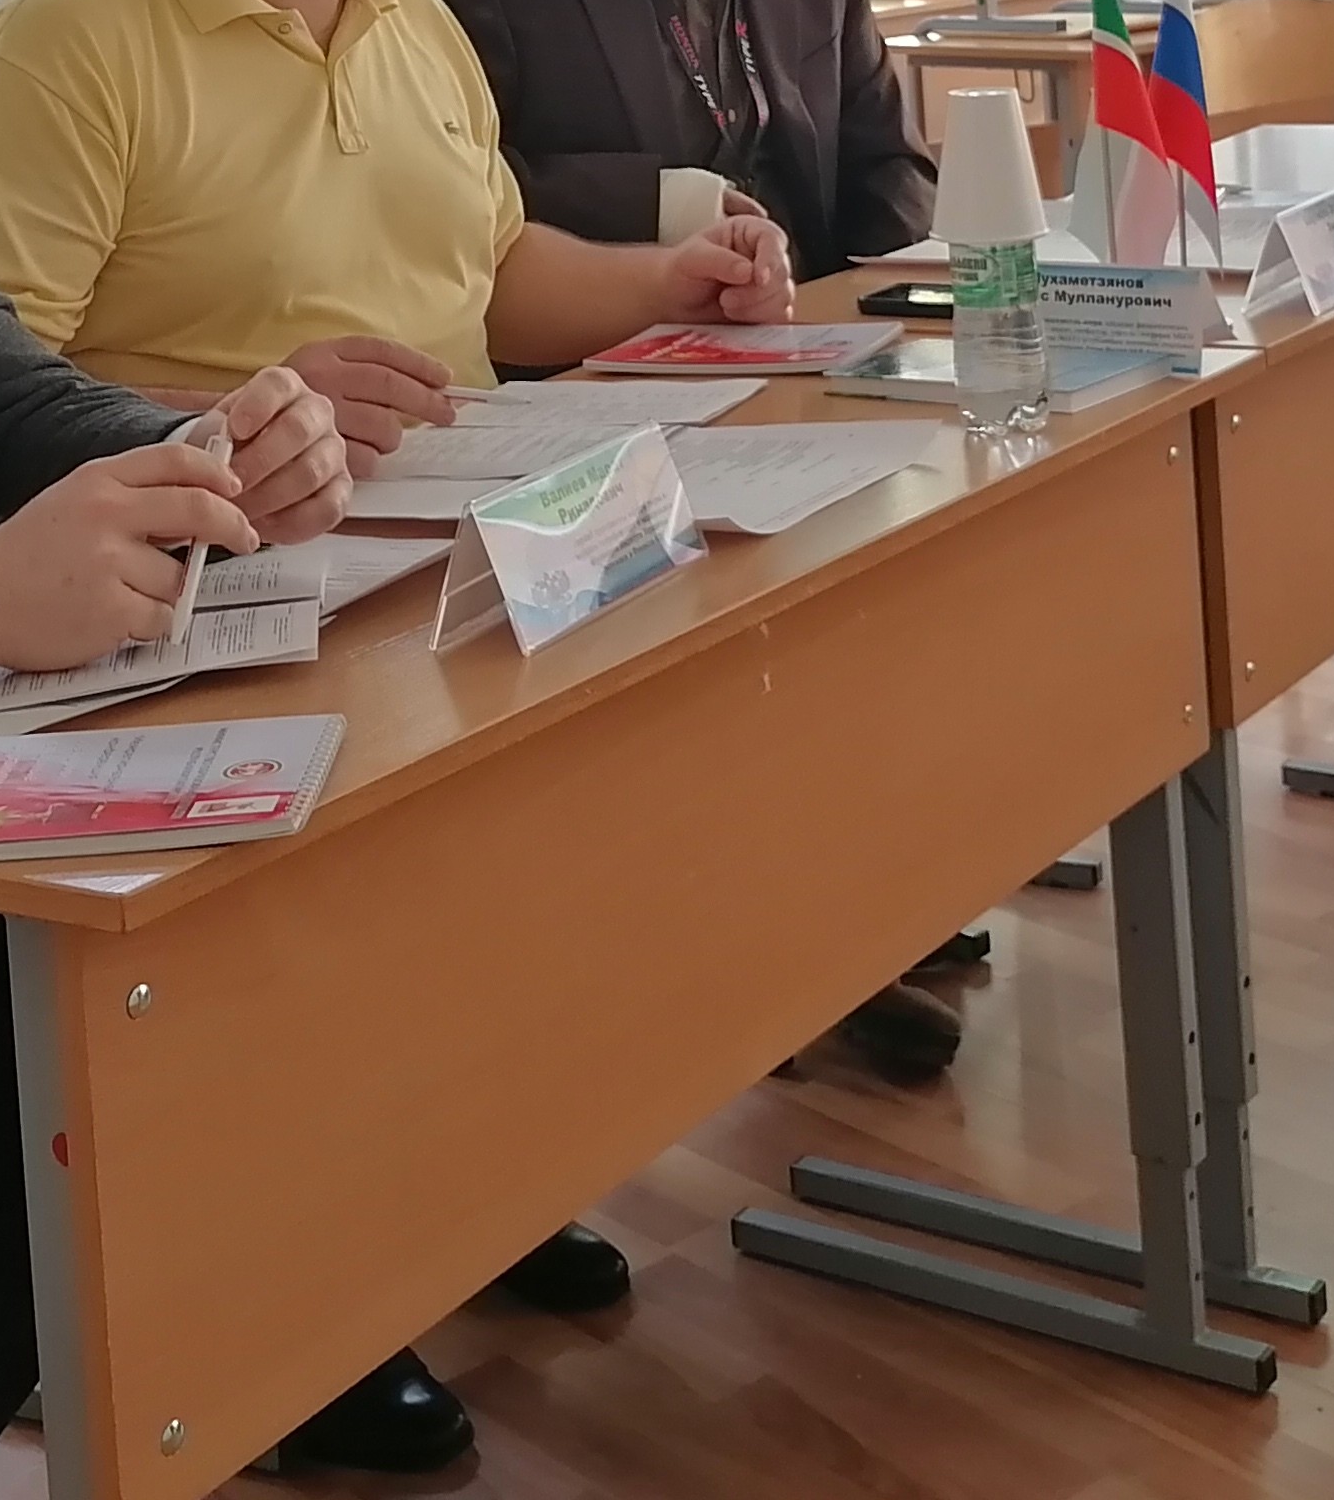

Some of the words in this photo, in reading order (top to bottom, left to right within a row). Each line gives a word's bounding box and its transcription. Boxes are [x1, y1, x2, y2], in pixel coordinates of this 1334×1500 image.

[1037, 272, 1144, 289] ухаметзянов
[1054, 290, 1172, 309] Мулланурович
[539, 476, 587, 508] Валиев
